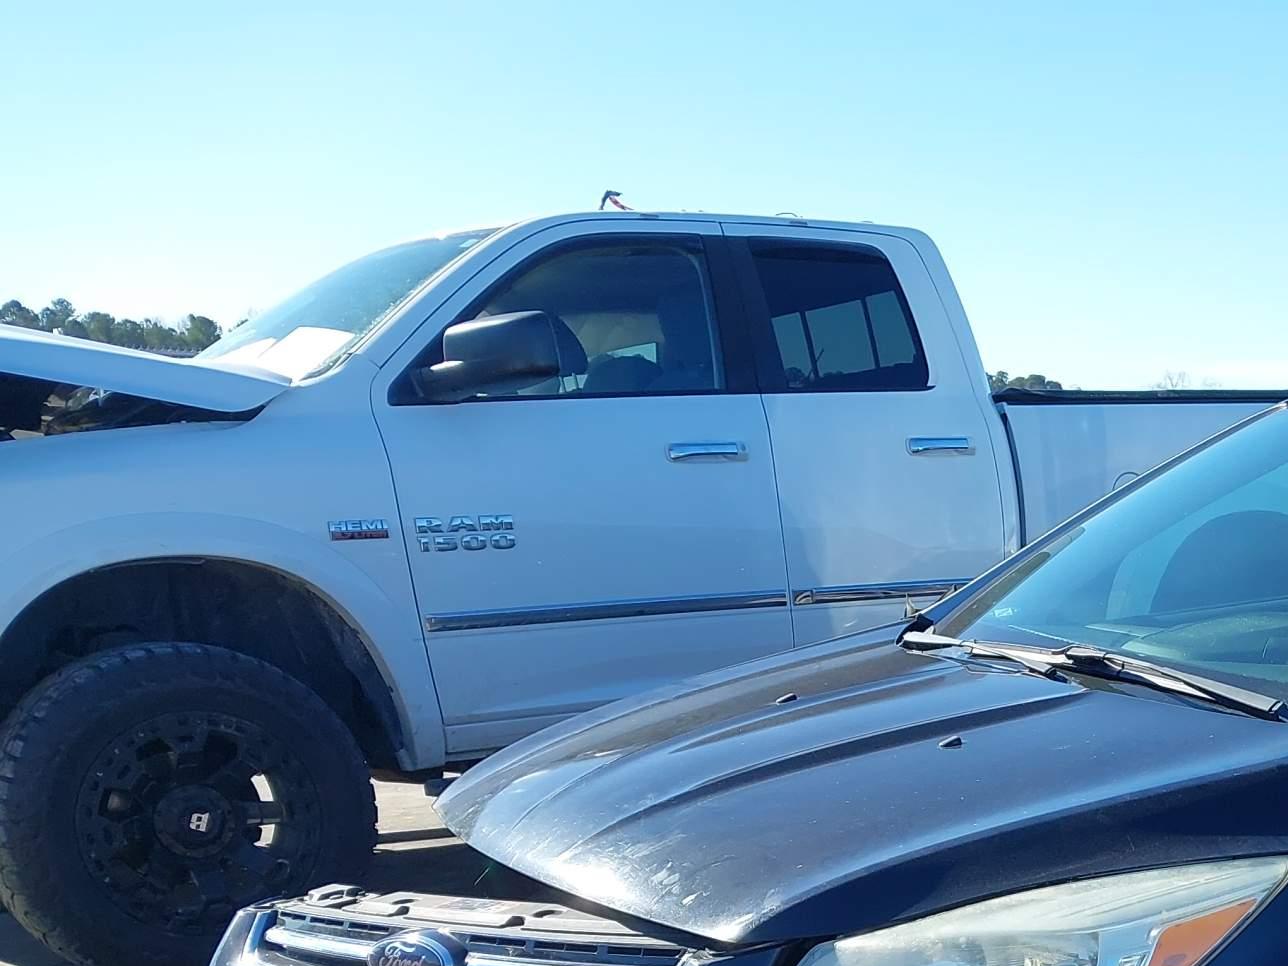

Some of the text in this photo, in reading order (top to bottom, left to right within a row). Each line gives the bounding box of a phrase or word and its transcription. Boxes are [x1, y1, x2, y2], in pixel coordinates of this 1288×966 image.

[328, 519, 389, 531] HEMI
[415, 515, 514, 533] RAM
[417, 533, 516, 552] 1500
